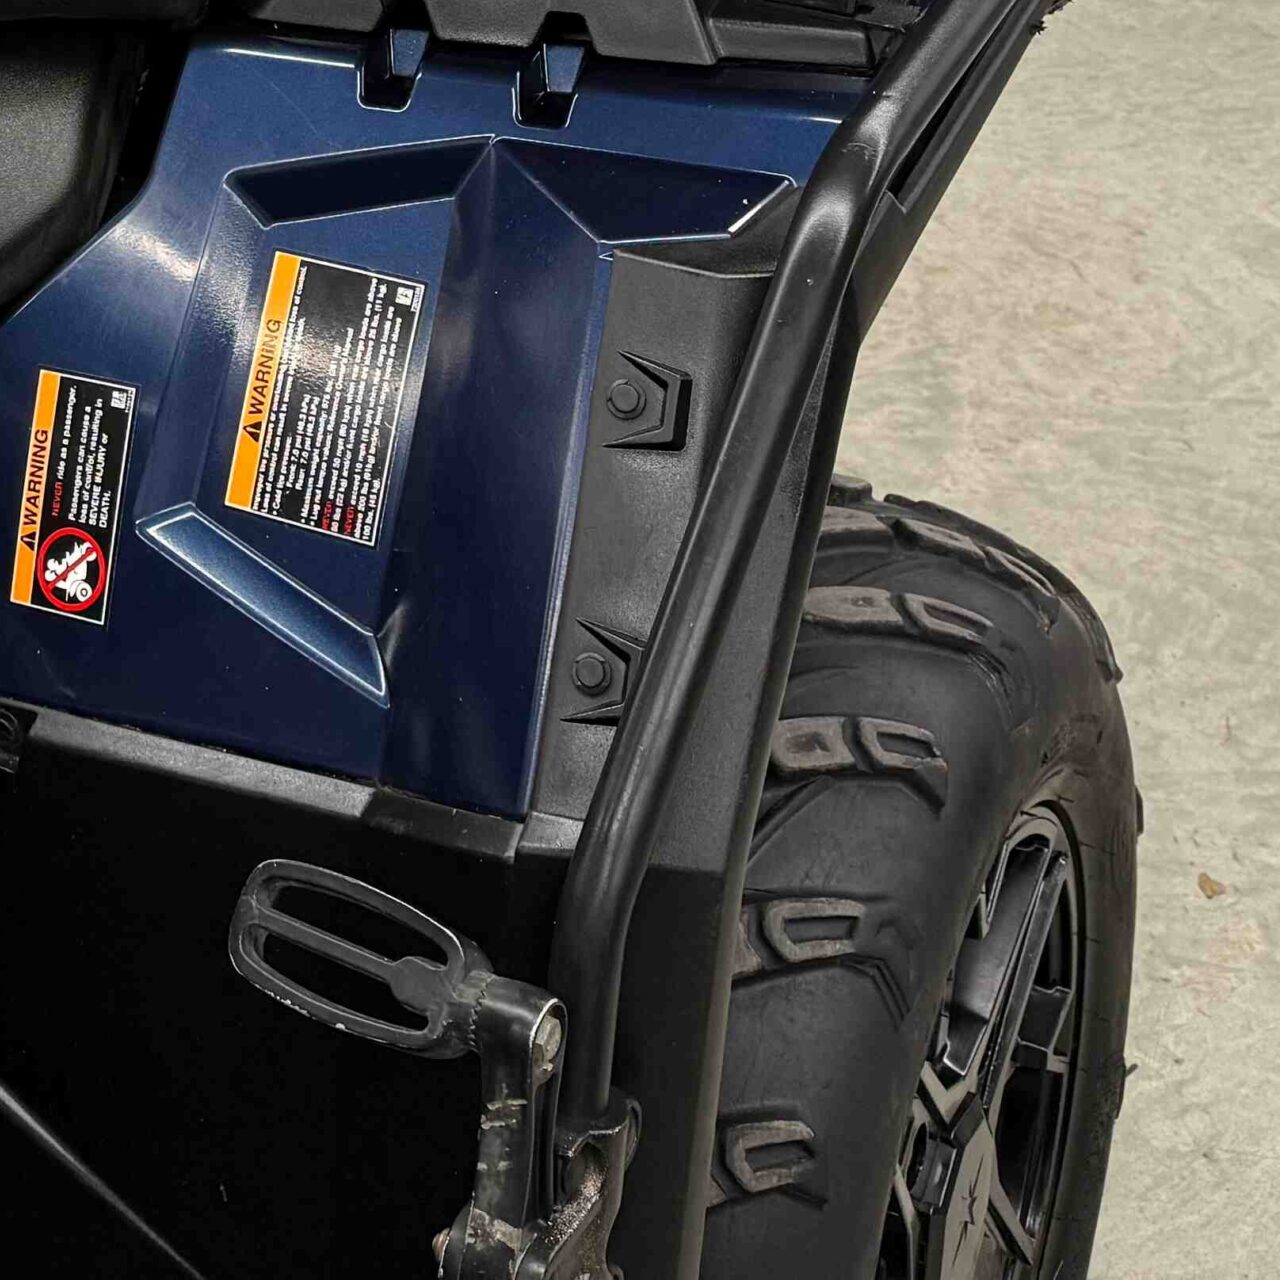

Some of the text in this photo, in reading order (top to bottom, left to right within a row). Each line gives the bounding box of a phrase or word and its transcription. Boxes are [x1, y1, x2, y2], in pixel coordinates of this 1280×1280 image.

[248, 319, 281, 414] WARNING
[63, 385, 76, 437] passenger.
[94, 398, 102, 407] in
[80, 414, 89, 443] cause
[89, 409, 102, 450] resulting
[60, 447, 67, 459] as
[77, 444, 85, 463] can
[290, 448, 299, 461] 7.0
[300, 450, 308, 463] 7.0
[56, 460, 65, 479] ride
[354, 462, 362, 472] 10
[22, 429, 48, 525] WARNING
[88, 432, 108, 525] SEVERE INJURY or
[51, 481, 62, 516] NEVER
[67, 465, 82, 520] Passengers
[82, 489, 89, 501] of
[78, 503, 88, 523] loss
[98, 490, 111, 528] DEATH.
[309, 503, 319, 520] Lug
[362, 524, 371, 539] 100
